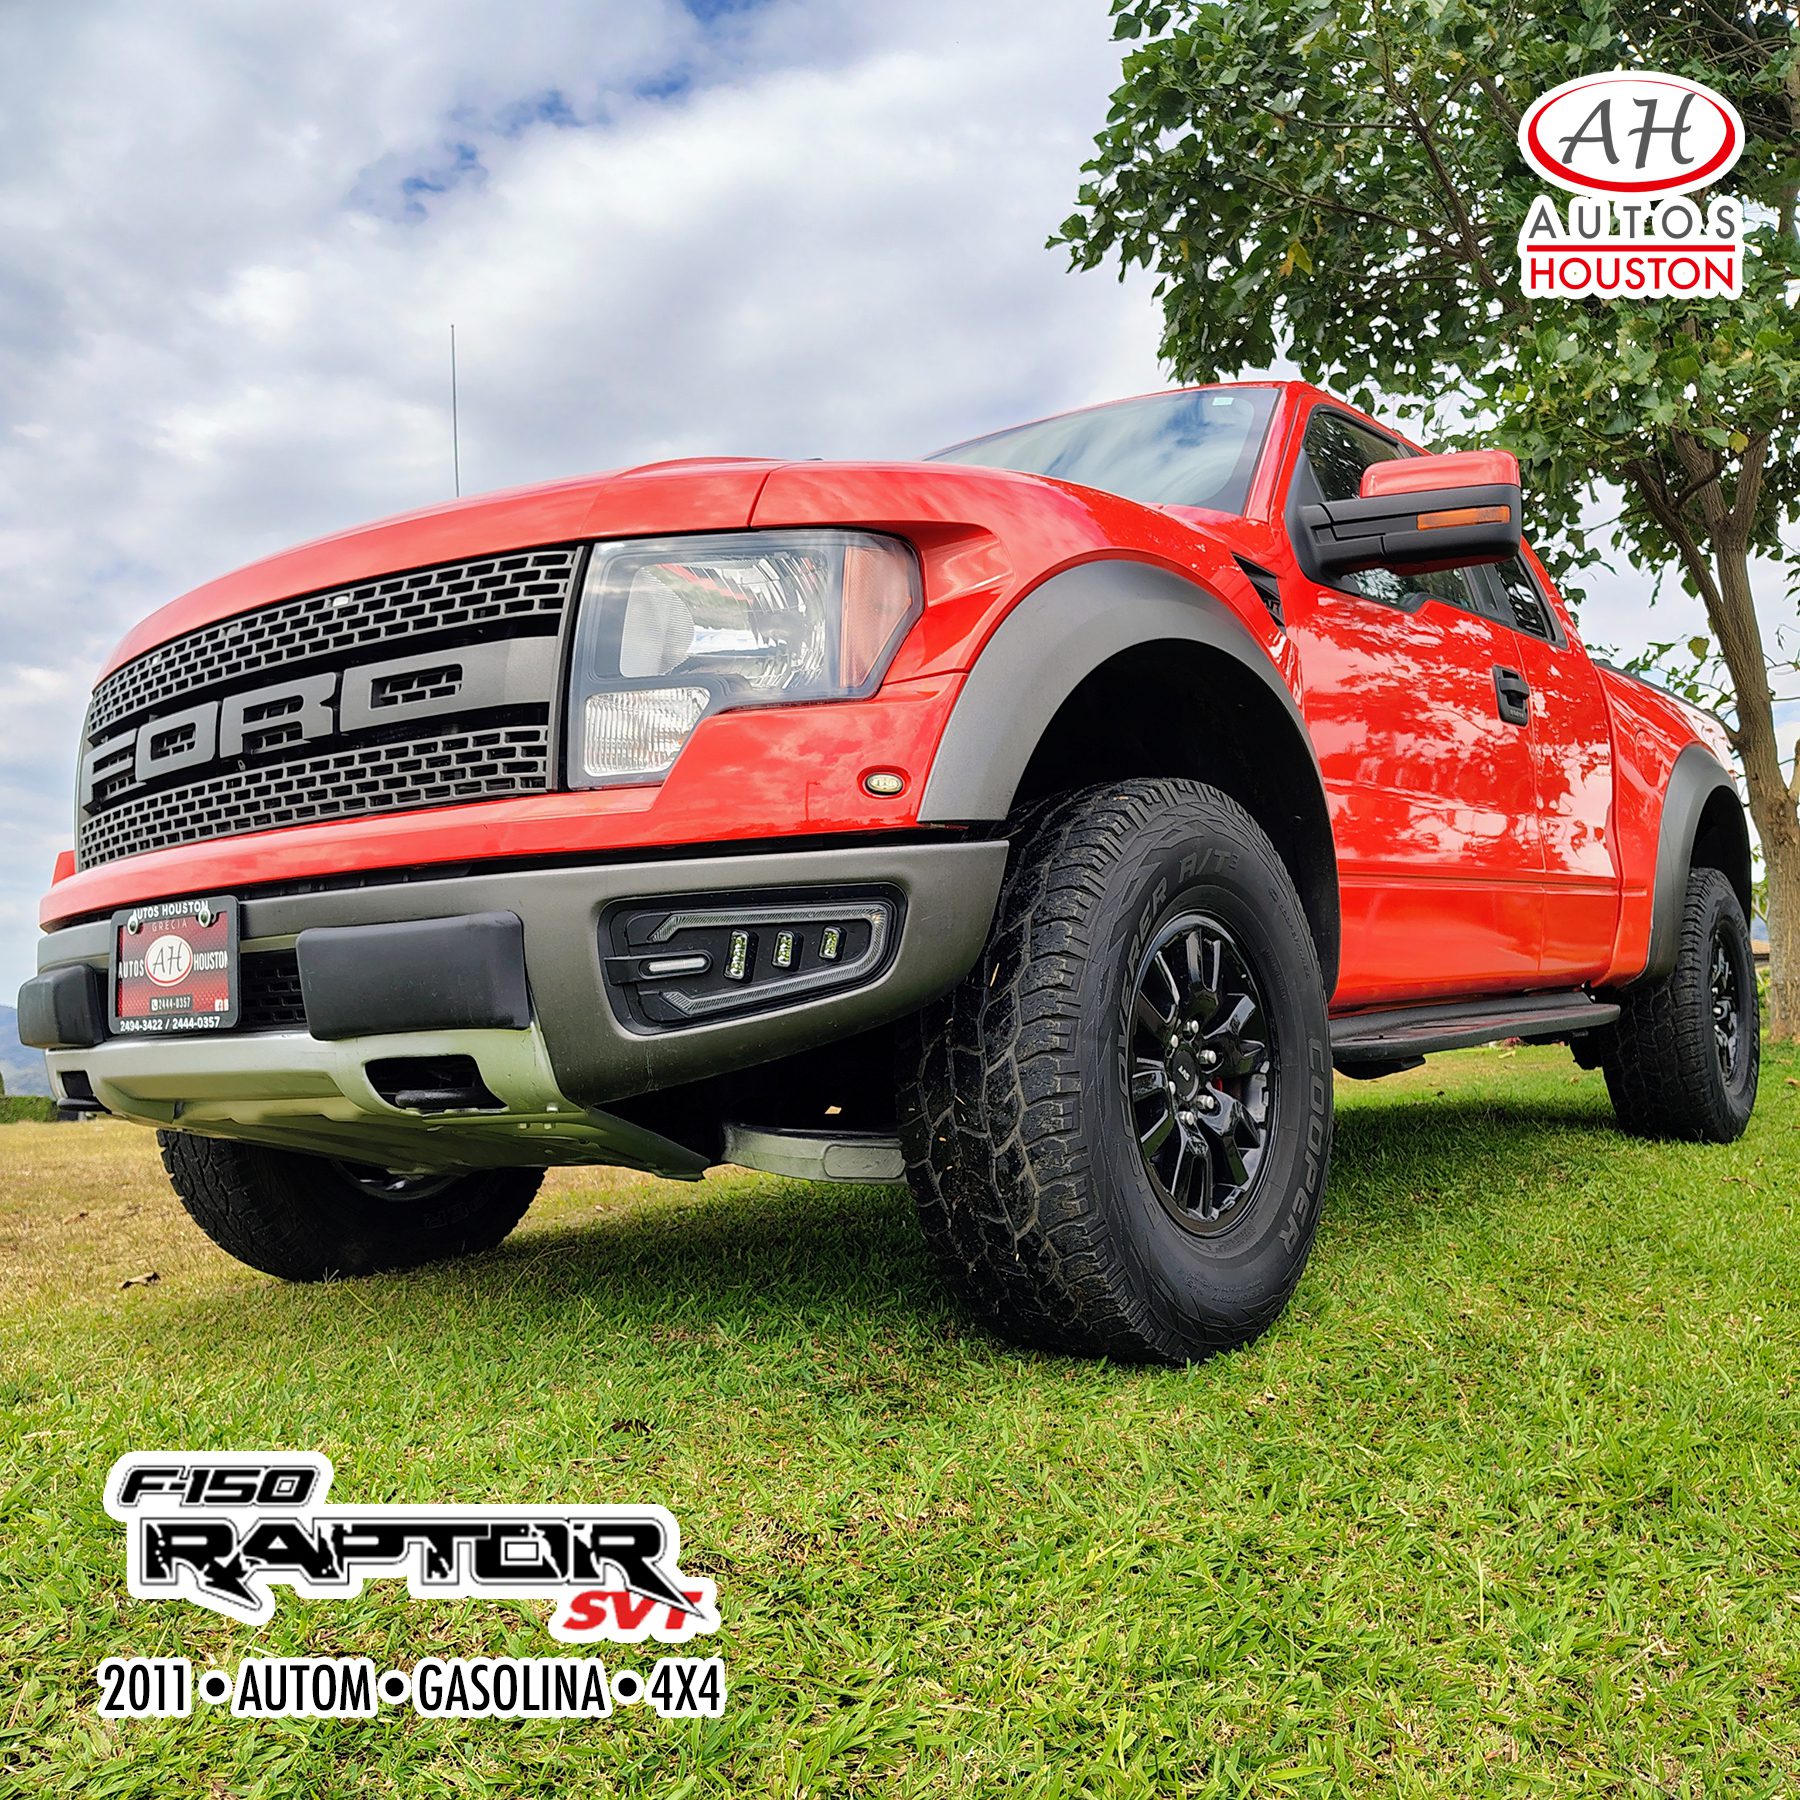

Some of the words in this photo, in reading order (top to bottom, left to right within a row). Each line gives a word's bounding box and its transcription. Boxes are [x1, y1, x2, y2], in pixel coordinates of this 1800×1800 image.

[82, 636, 556, 807] FORD
[133, 906, 159, 920] AUTOS
[162, 900, 209, 916] HOUSTON
[152, 919, 188, 932] GRECIA
[118, 961, 144, 979] AUTOS
[152, 942, 183, 976] AH
[158, 997, 191, 1010] 2444-0357
[120, 1019, 163, 1032] 2494-3422
[172, 1016, 221, 1030] 2444-0357
[1278, 1037, 1327, 1256] COOPER
